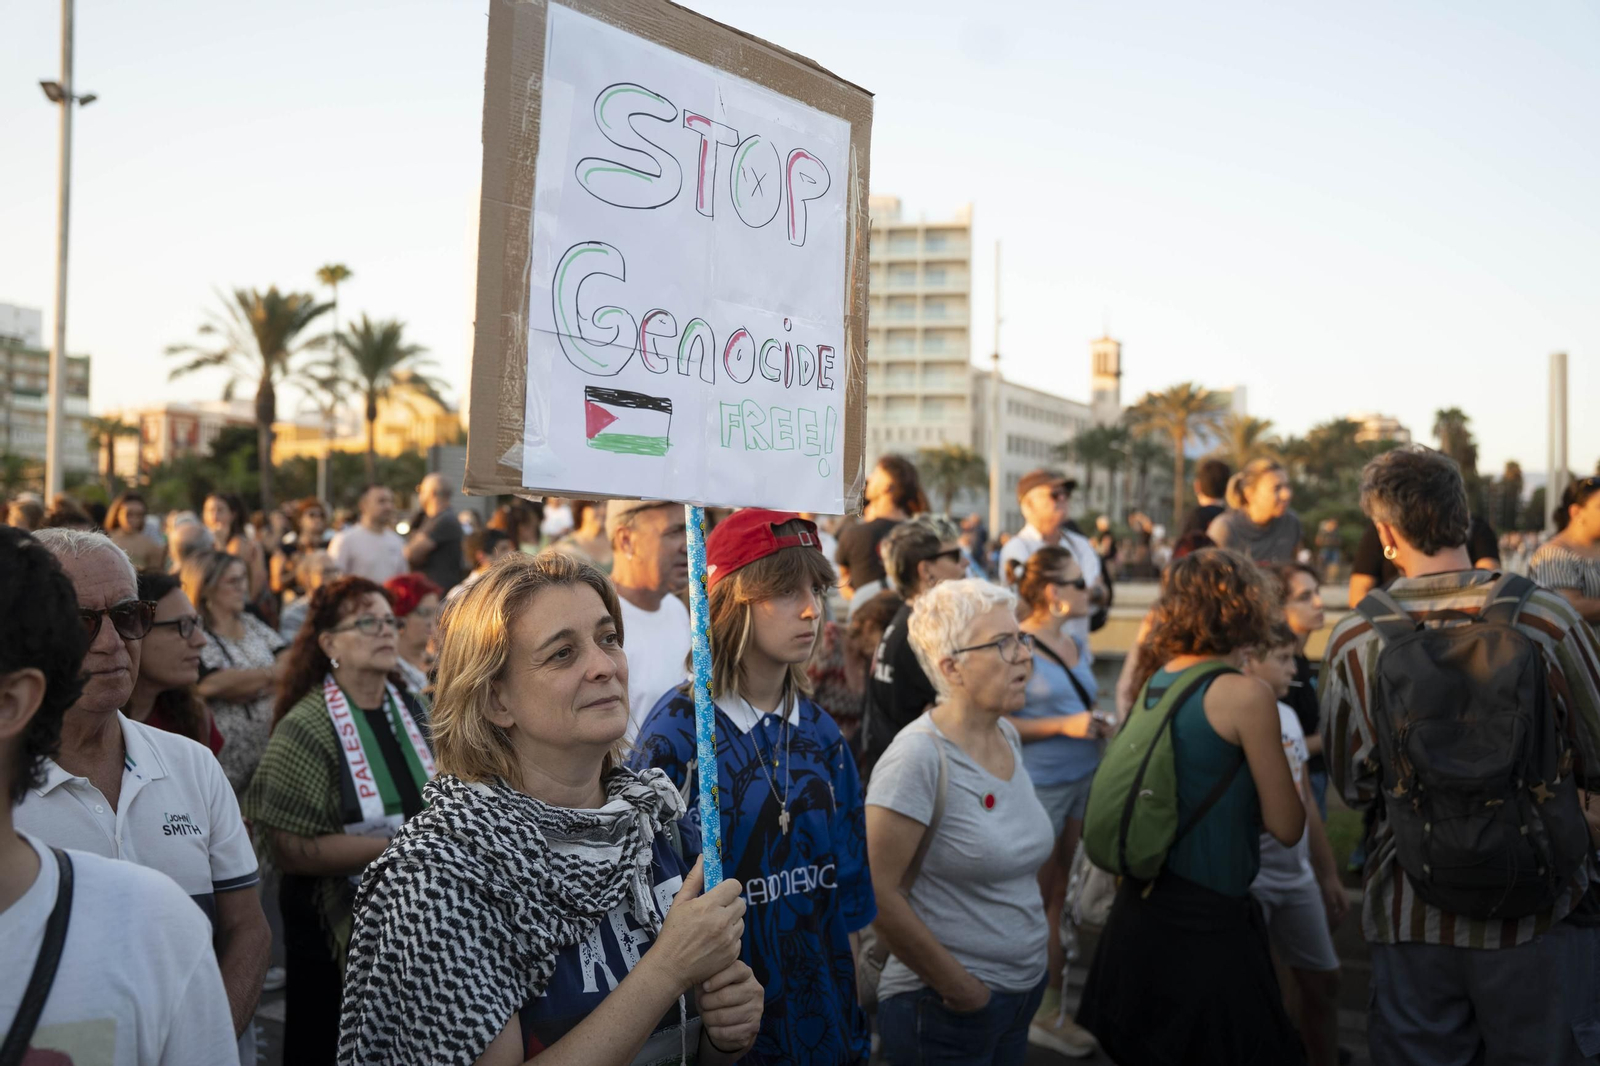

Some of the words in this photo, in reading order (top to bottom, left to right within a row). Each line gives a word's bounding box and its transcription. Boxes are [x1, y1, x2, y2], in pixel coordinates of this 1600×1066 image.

[574, 82, 831, 247] STOP
[719, 399, 838, 478] FREE!
[162, 823, 202, 837] SMITH
